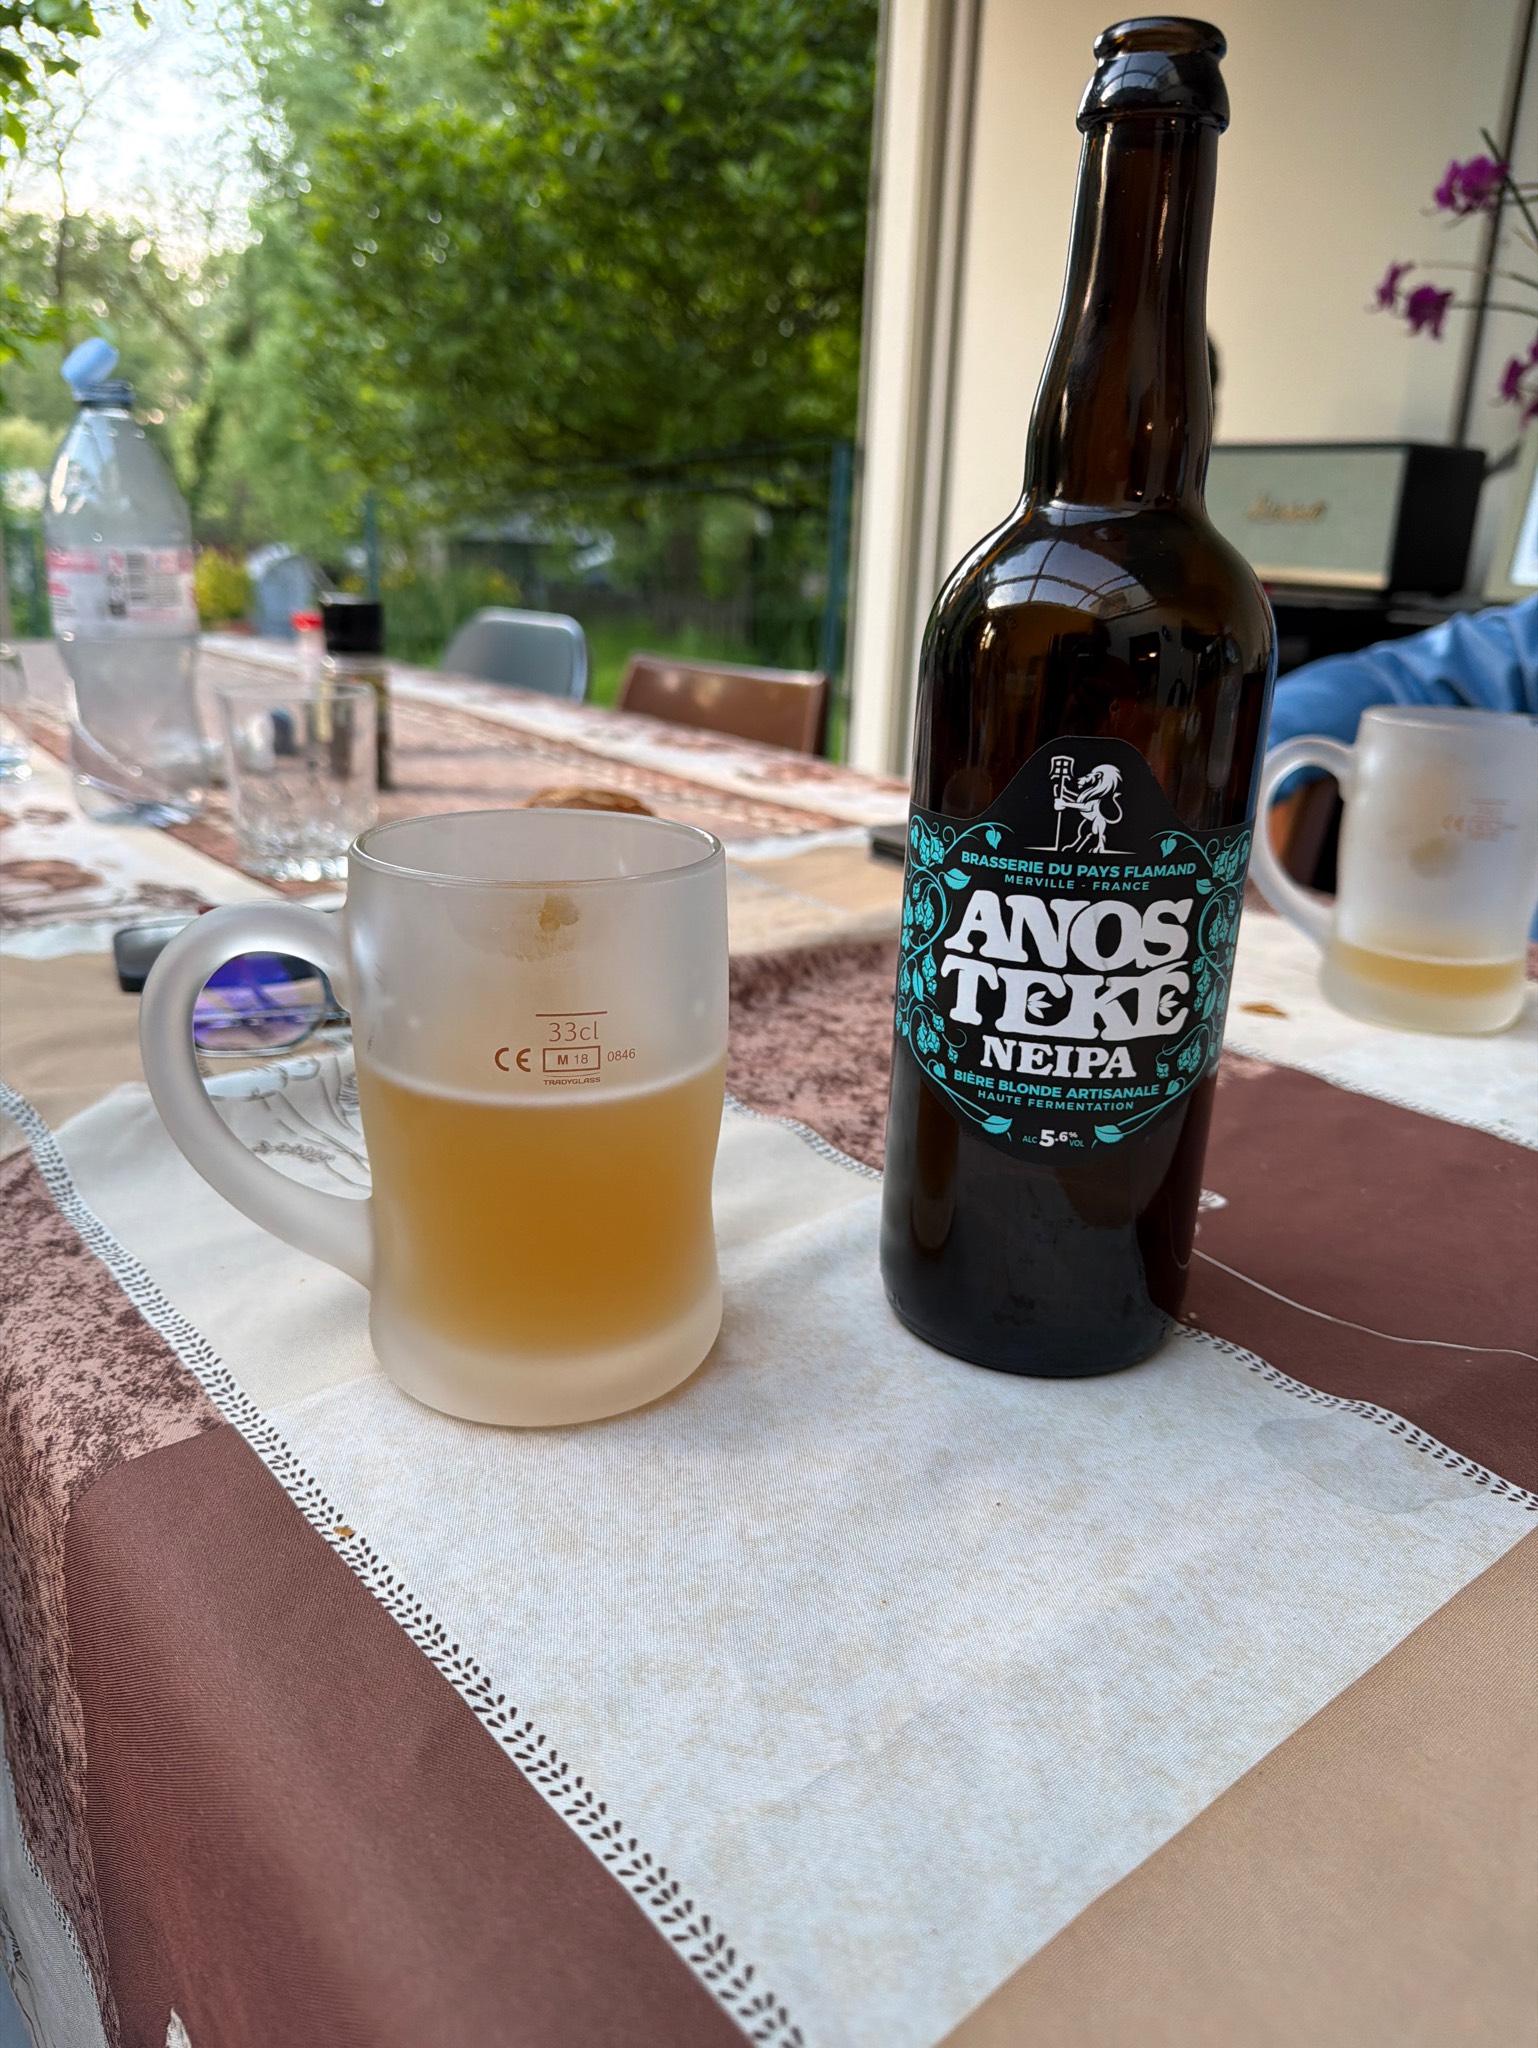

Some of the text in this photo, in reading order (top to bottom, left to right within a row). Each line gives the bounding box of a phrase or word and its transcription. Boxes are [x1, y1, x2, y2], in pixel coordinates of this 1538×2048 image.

[961, 850, 1197, 878] BRASSERIE DU PAYS FLAMAND
[1004, 874, 1075, 890] MERVILLE
[1092, 881, 1150, 891] FRANCE
[944, 889, 1194, 971] ANOS
[548, 1020, 599, 1042] 33cl
[494, 1047, 531, 1072] CE
[557, 1053, 589, 1065] M 18
[607, 1048, 636, 1062] 0846
[980, 1035, 1137, 1080] NEIPA
[543, 1076, 601, 1086] TRADYGLASS
[953, 1069, 1160, 1100] BIÈRE BLONDE ARTISANALE
[977, 1090, 1135, 1111] HAUTE FERMENTATION
[1022, 1135, 1038, 1144] ALC
[1069, 1139, 1085, 1147] VOL
